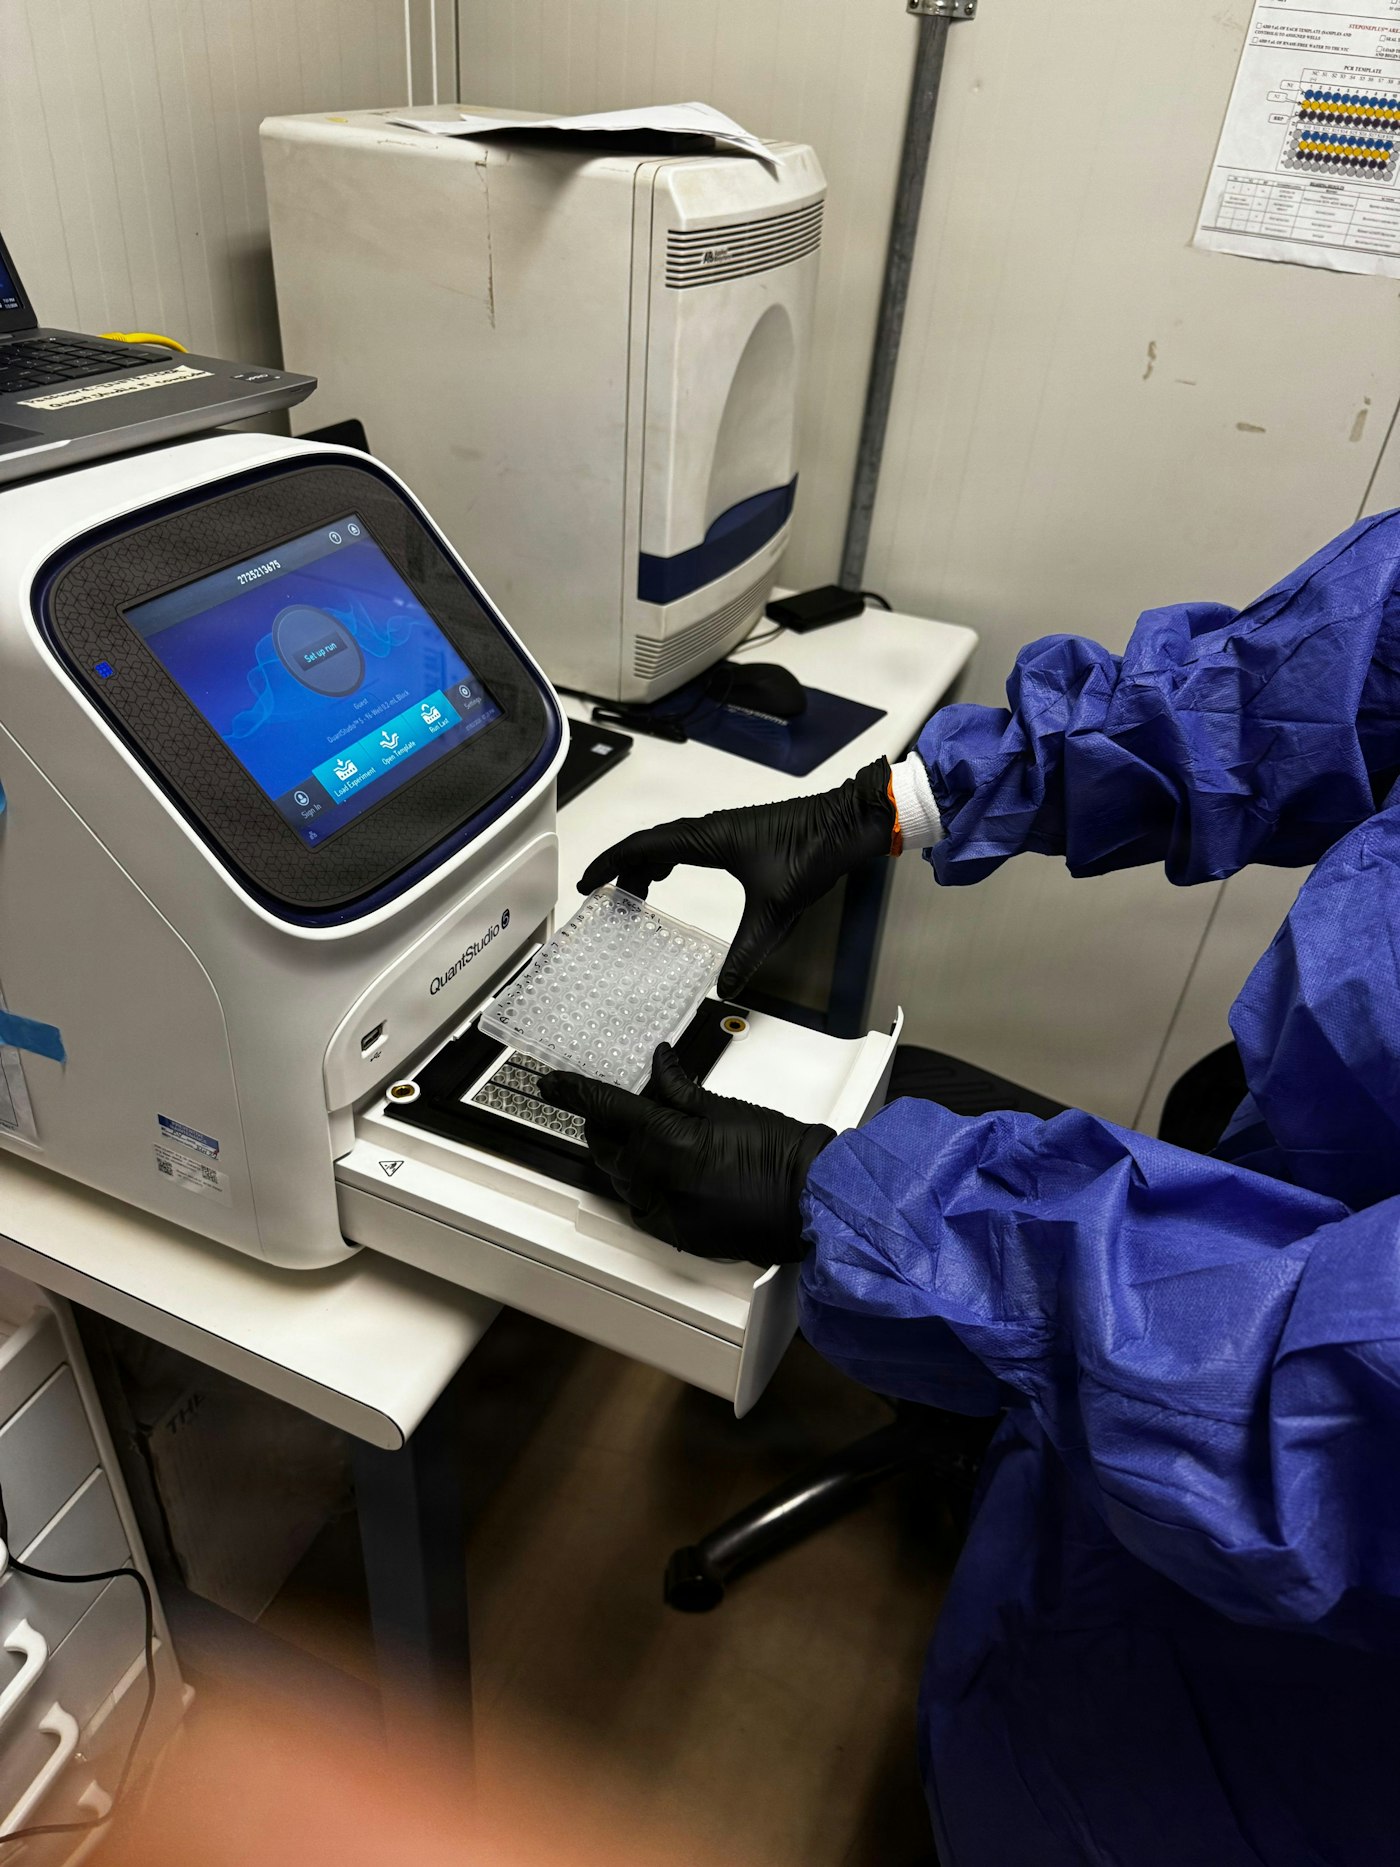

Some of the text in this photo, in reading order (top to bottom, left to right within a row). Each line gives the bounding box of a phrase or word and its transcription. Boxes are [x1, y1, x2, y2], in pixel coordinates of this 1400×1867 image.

[1355, 66, 1382, 74] TEMPLATE
[237, 560, 281, 585] 2725213675
[304, 643, 337, 663] Set up run
[353, 698, 368, 710] Guest
[395, 690, 409, 701] Block
[438, 718, 449, 728] Last
[382, 740, 416, 766] Open Template
[334, 767, 377, 797] Load Experiment
[301, 803, 322, 819] Sign In
[430, 910, 509, 995] QuantStudio 5
